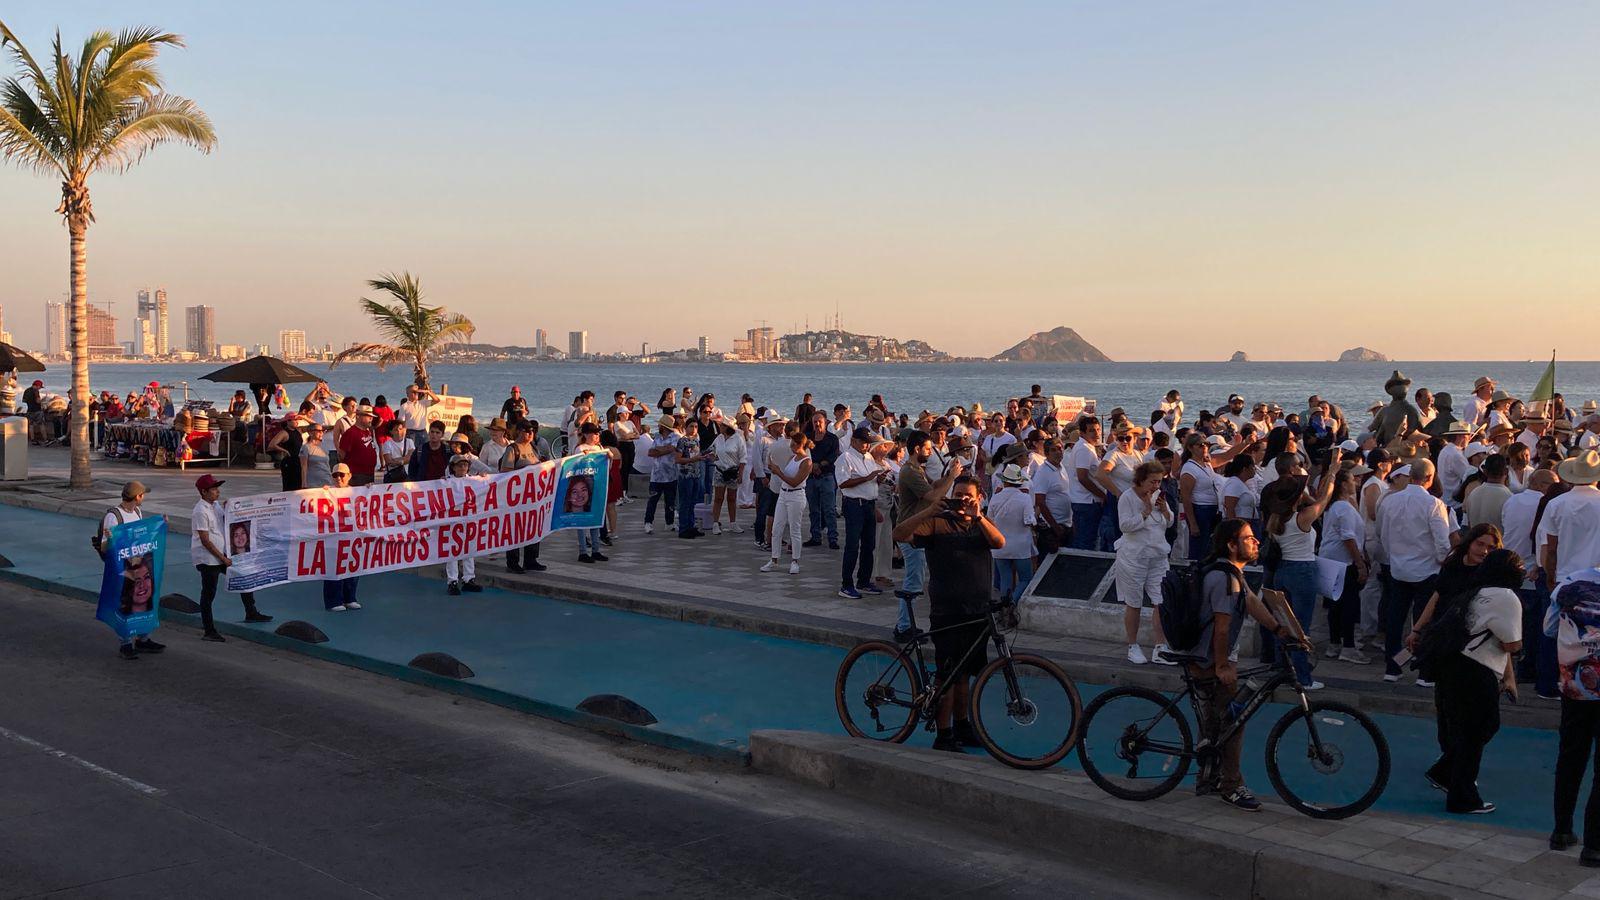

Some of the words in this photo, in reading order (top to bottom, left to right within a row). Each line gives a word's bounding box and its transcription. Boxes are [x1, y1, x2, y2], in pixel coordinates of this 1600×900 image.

[484, 482, 498, 512] A
[506, 467, 556, 507] CASA
[118, 547, 130, 562] ¡SE
[131, 540, 158, 556] BUSCA!
[298, 540, 326, 576] LA
[336, 528, 431, 575] ESTAMOS
